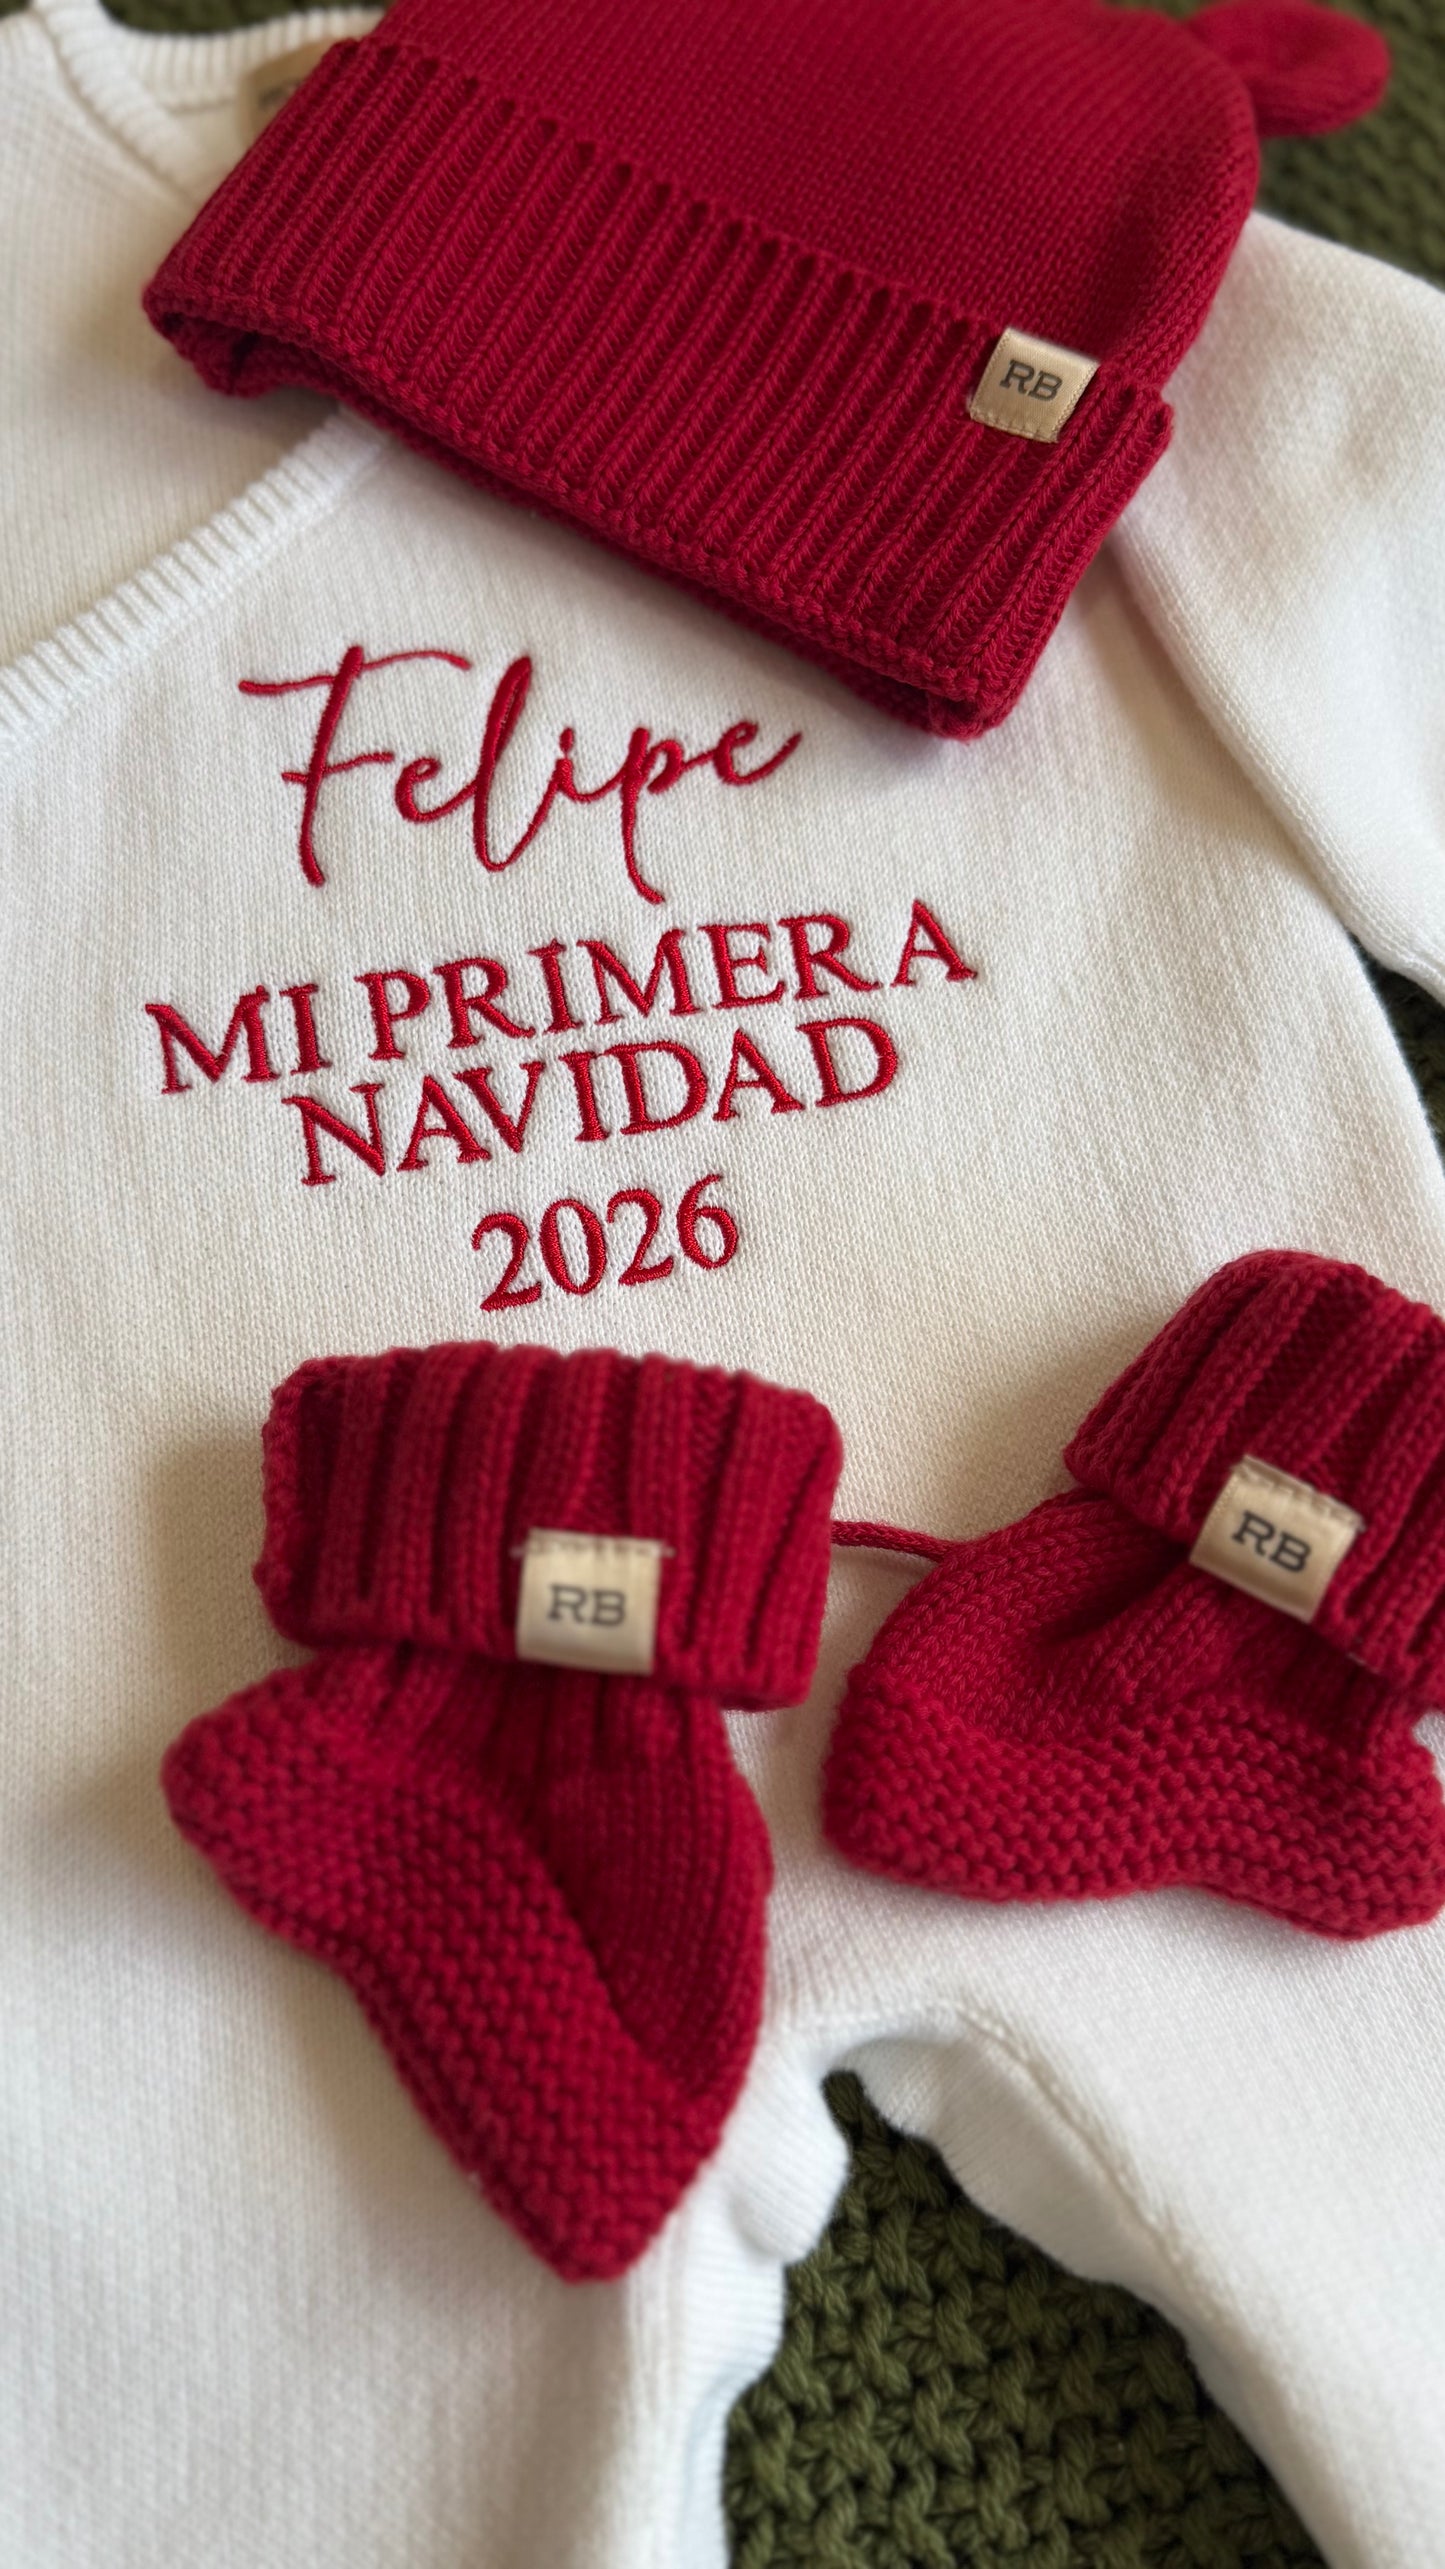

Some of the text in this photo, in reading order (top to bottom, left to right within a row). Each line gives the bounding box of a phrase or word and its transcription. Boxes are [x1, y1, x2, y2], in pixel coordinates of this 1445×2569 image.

[999, 359, 1063, 401] RB
[238, 645, 802, 905] Felipe
[145, 899, 979, 1094] MI PRIMERA
[282, 1016, 899, 1187] NAVIDAD
[471, 1173, 740, 1312] 2026
[547, 1583, 626, 1627] RB
[1231, 1509, 1312, 1573] RB
